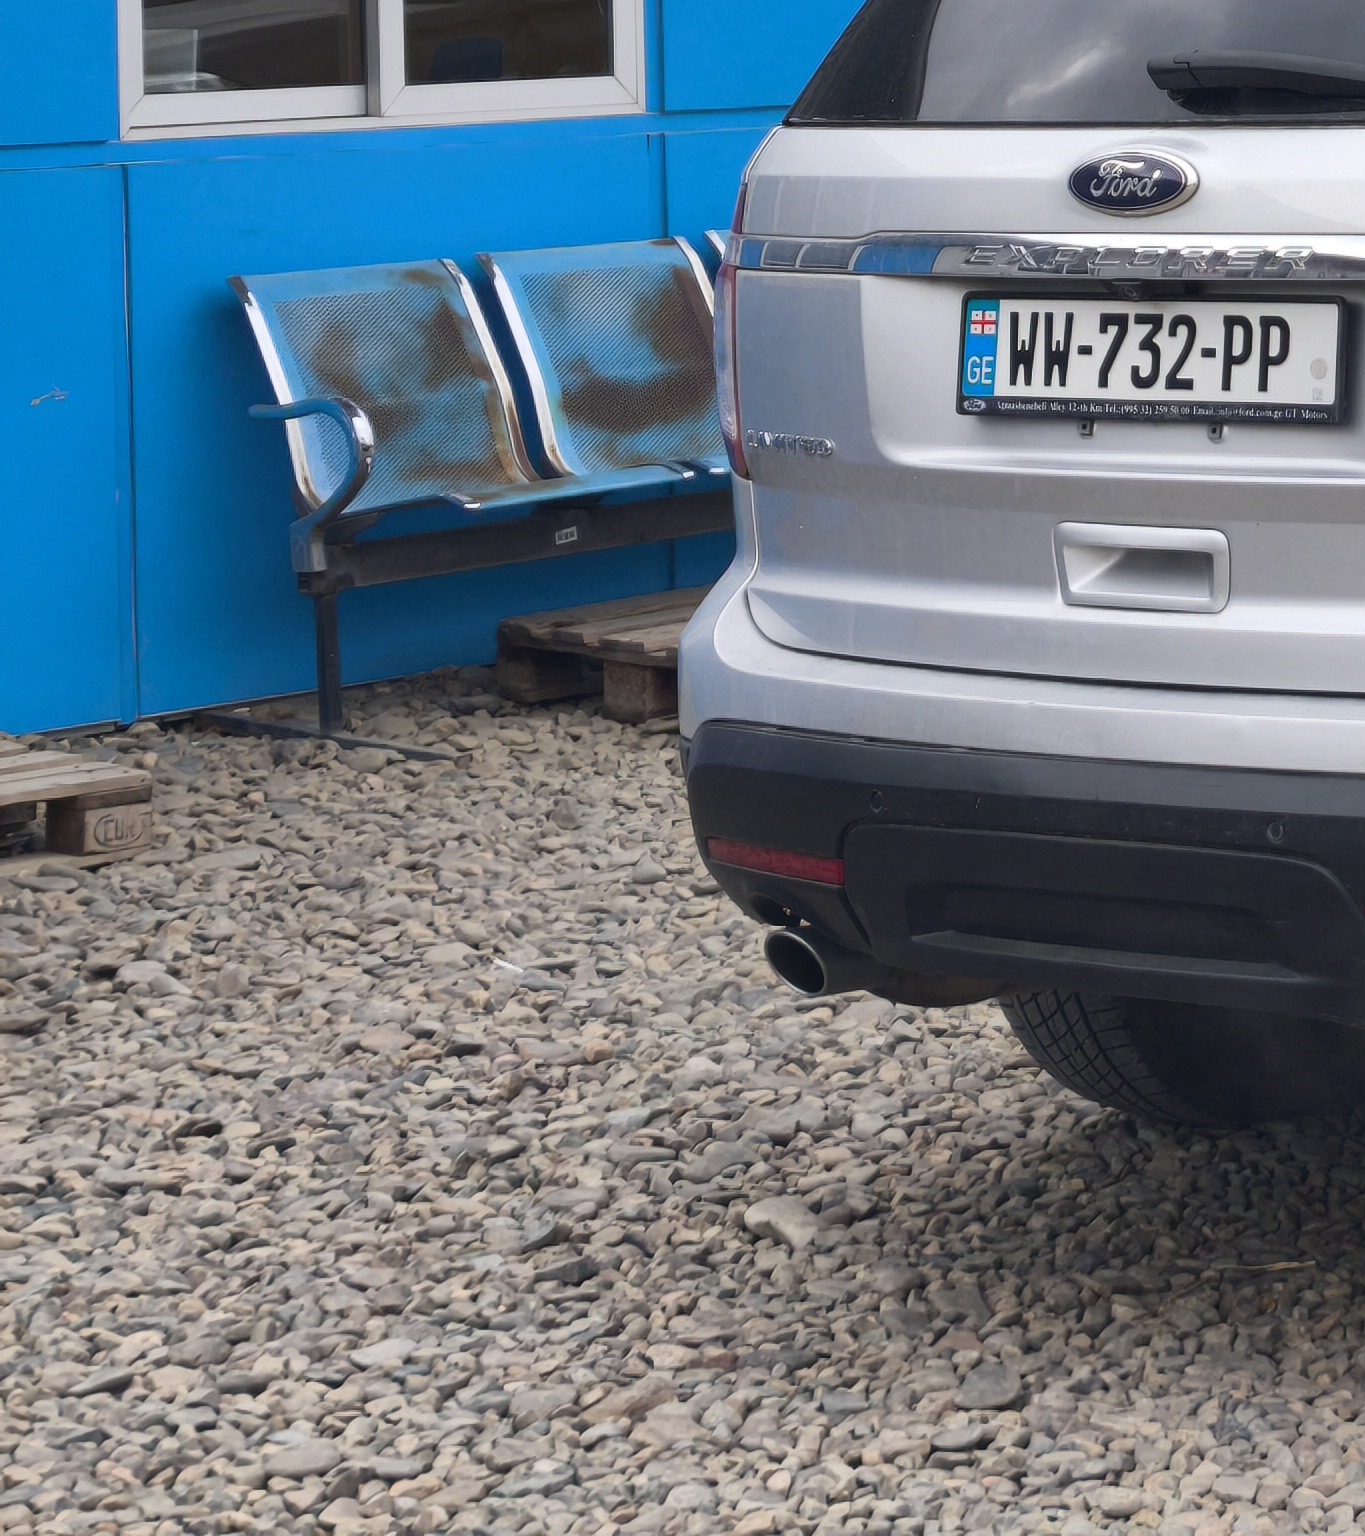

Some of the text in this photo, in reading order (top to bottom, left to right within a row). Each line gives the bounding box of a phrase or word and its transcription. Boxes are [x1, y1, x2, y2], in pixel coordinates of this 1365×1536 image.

[1089, 159, 1162, 198] Ford
[964, 244, 1315, 272] EXPLORER
[1009, 311, 1291, 393] WW-732-PP
[966, 355, 995, 386] GE
